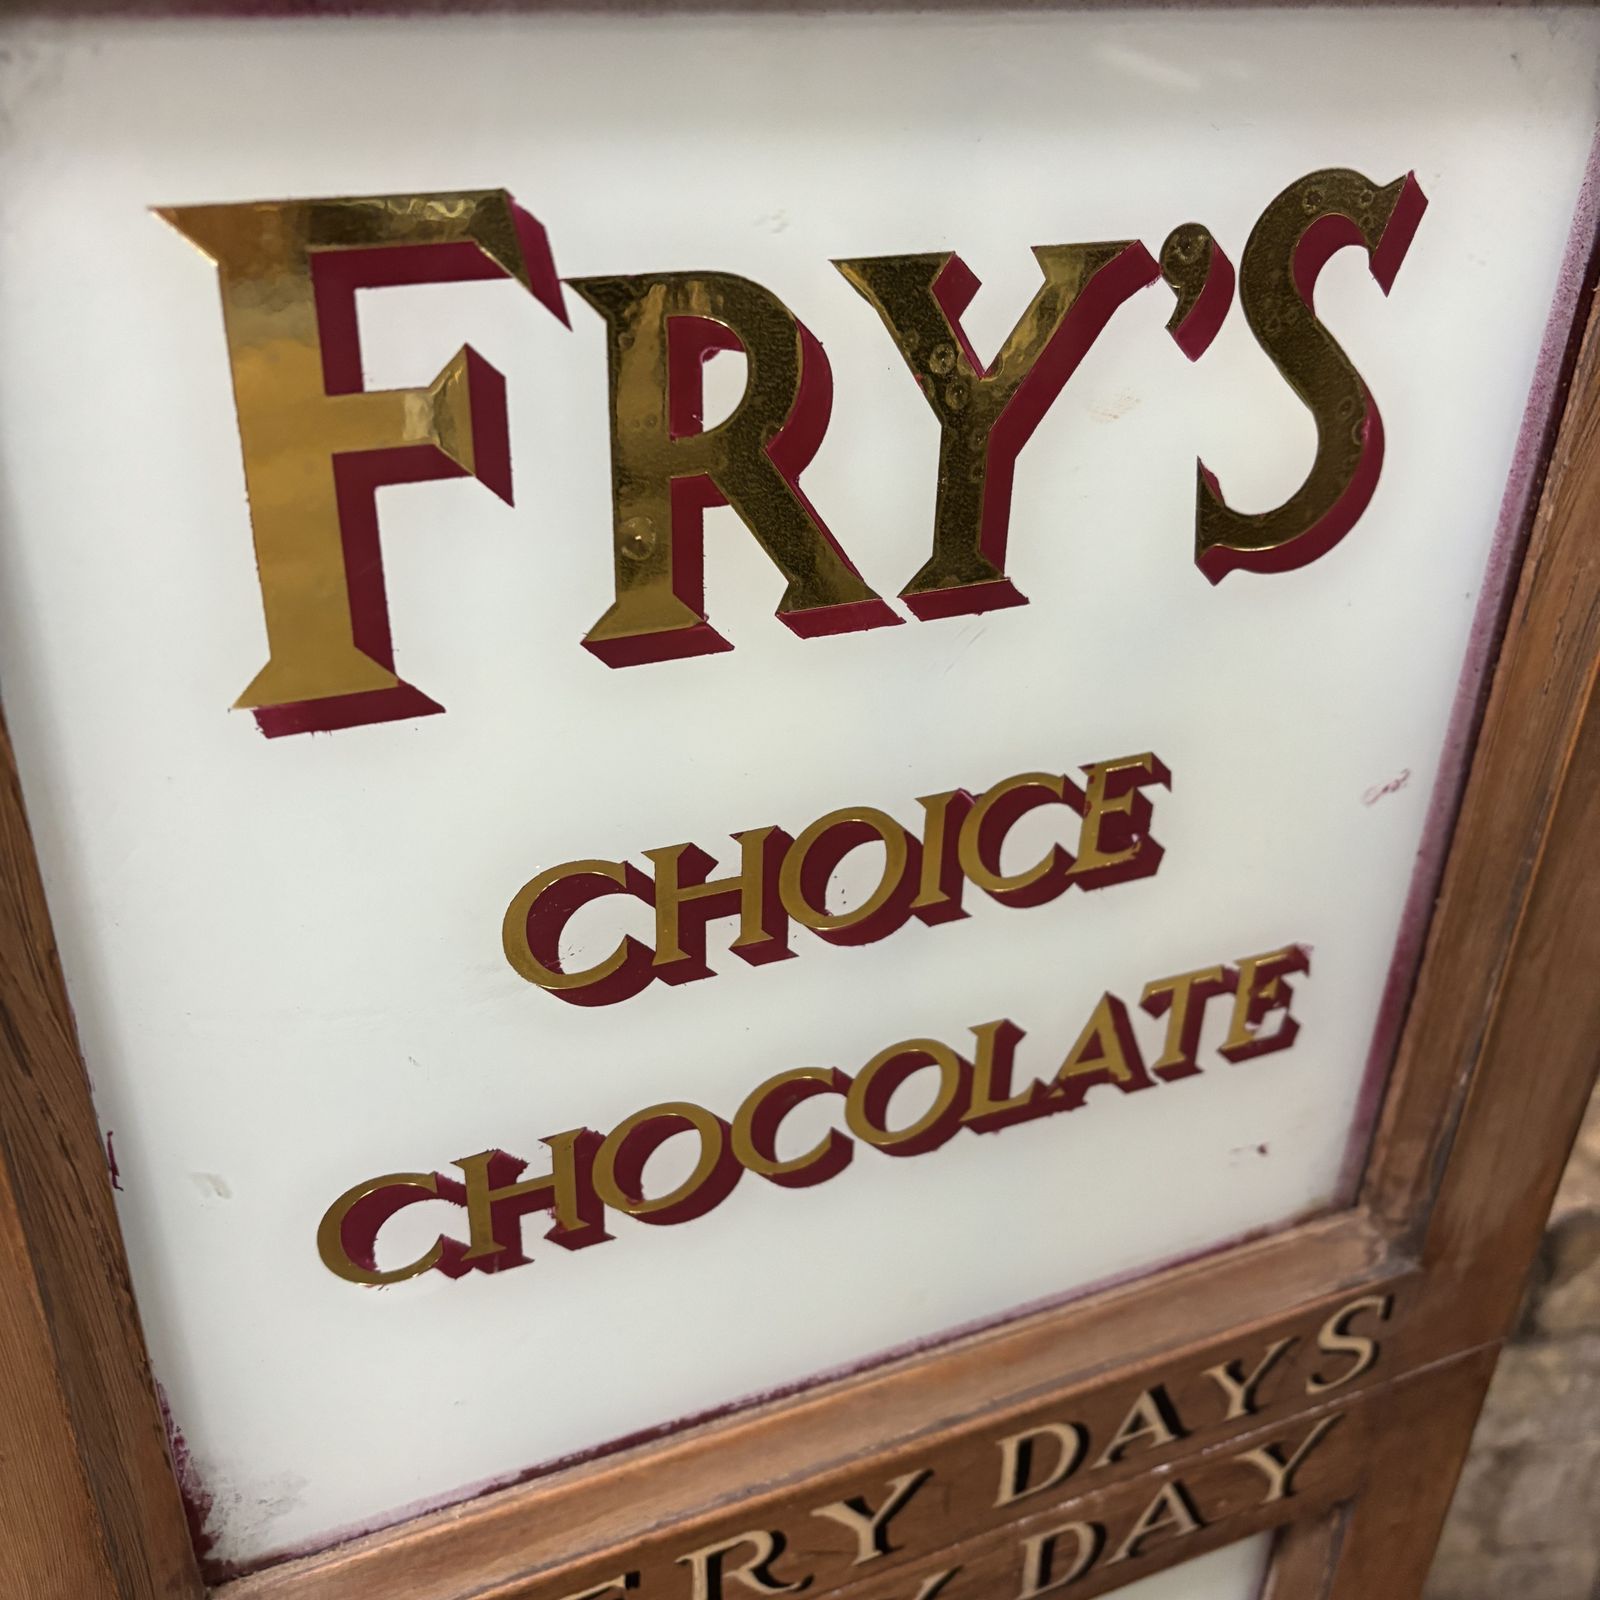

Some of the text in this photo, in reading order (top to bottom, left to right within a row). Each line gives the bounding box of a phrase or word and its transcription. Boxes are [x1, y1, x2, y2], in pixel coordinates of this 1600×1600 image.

[149, 167, 1429, 738] FRY'S
[502, 752, 1173, 1006] CHOICE
[317, 944, 1311, 1287] CHOCOLATE
[560, 1294, 1394, 1600] RY DAYS
[1017, 1412, 1345, 1600] DAY
